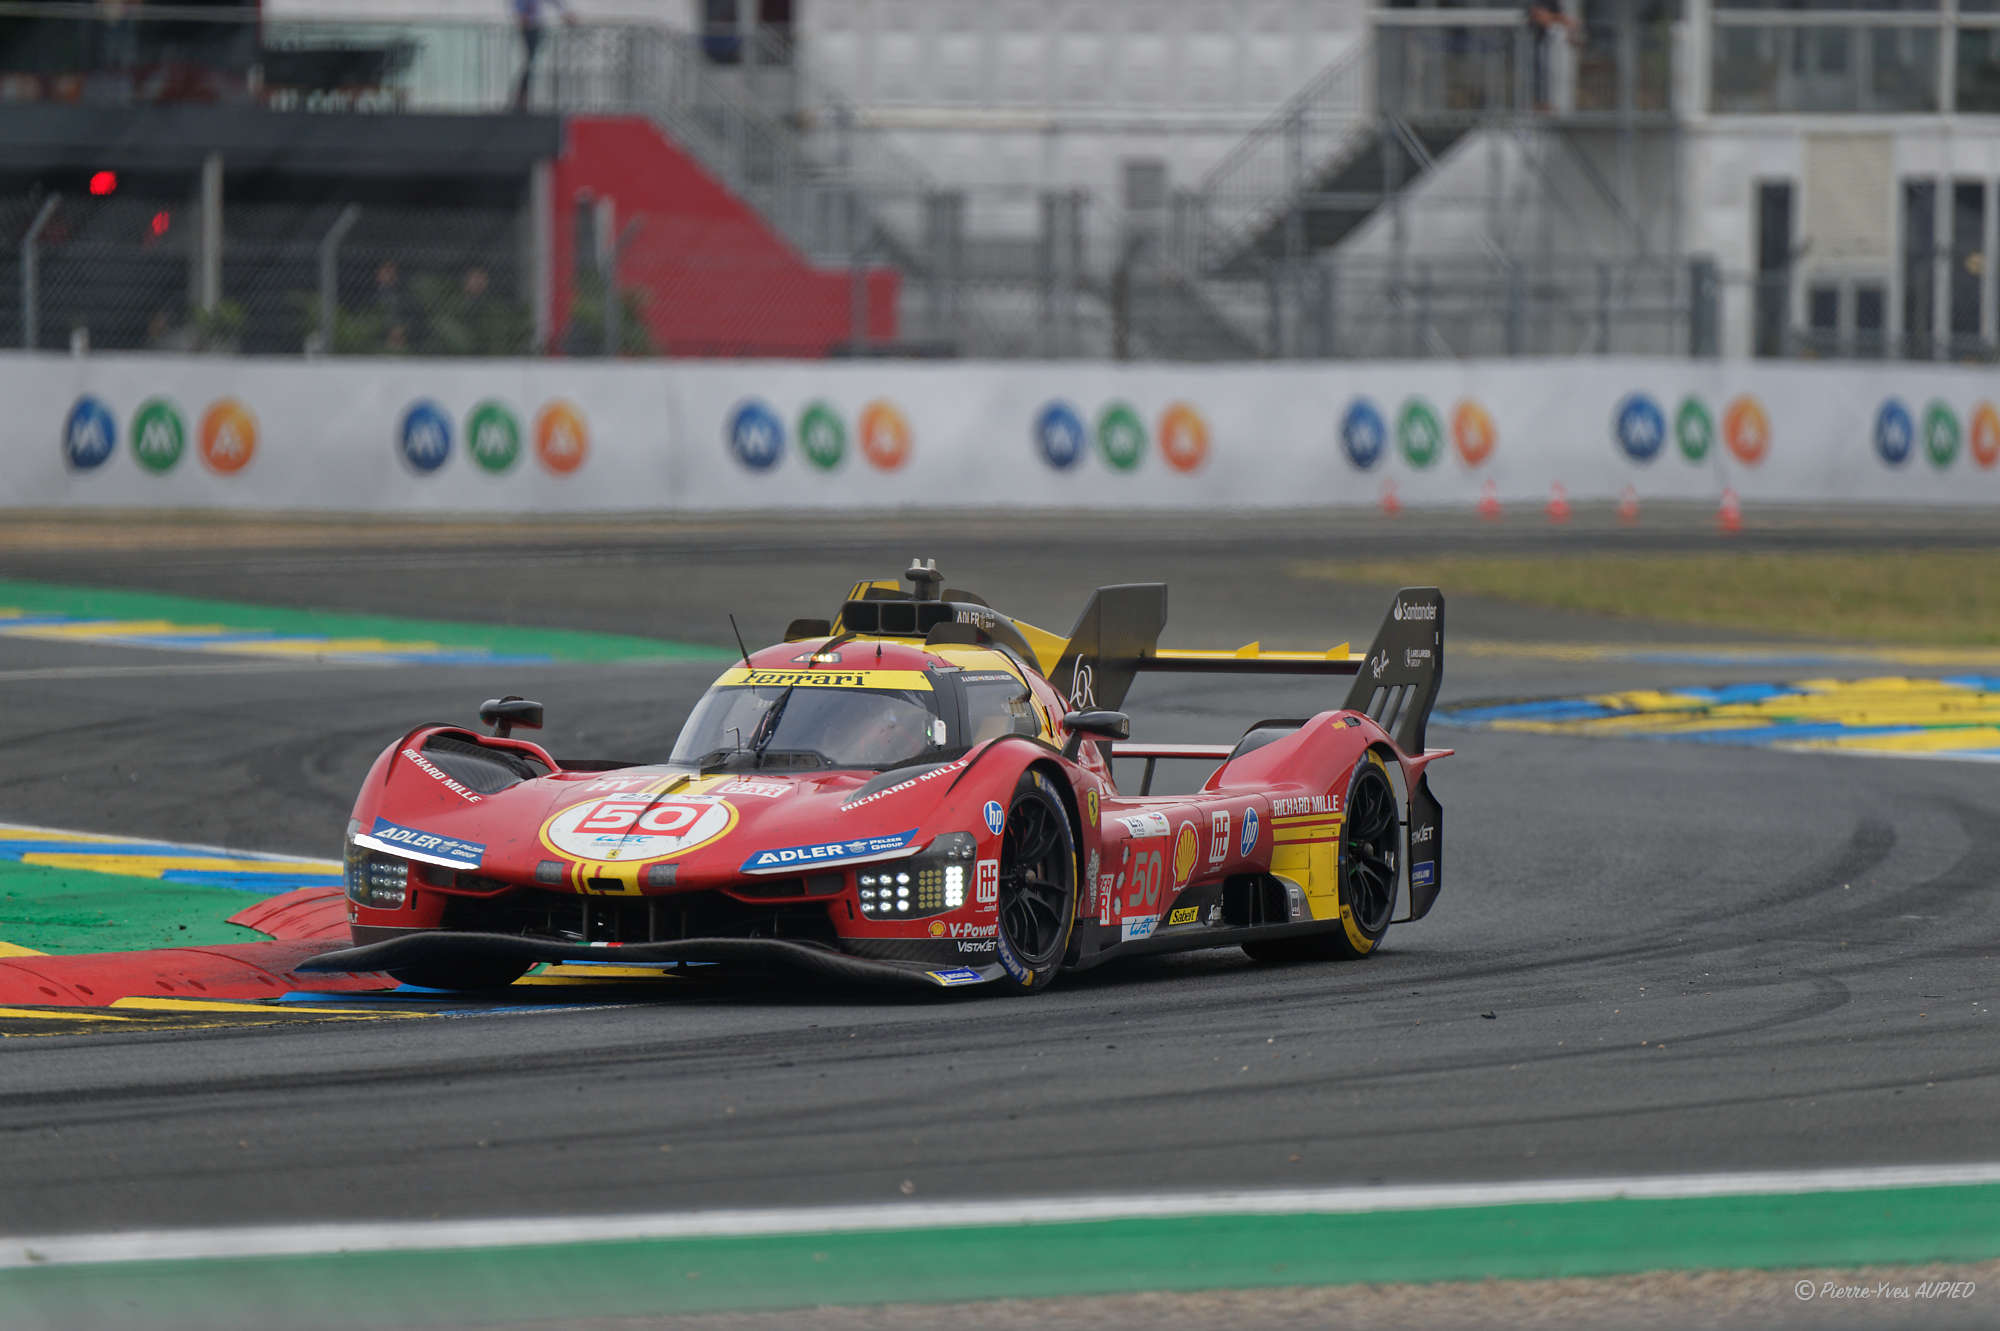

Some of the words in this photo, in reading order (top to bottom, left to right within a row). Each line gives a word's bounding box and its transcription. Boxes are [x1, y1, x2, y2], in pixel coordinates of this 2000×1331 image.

[1403, 602, 1437, 620] Santander
[738, 669, 871, 686] Ferrari
[402, 748, 447, 780] RICHARD
[441, 778, 482, 803] MILLE
[840, 780, 917, 812] RICHARD
[919, 760, 969, 782] MILLE
[1273, 797, 1310, 816] RICHARD
[1312, 794, 1339, 813] MILLE
[584, 804, 698, 831] 50
[989, 803, 1002, 834] hp
[374, 827, 442, 849] ADLER
[869, 837, 902, 846] PELZER
[1243, 809, 1257, 855] hp
[756, 844, 844, 865] ADLER
[871, 841, 904, 850] GROUP
[1129, 850, 1162, 906] 50
[949, 922, 997, 938] V-Power
